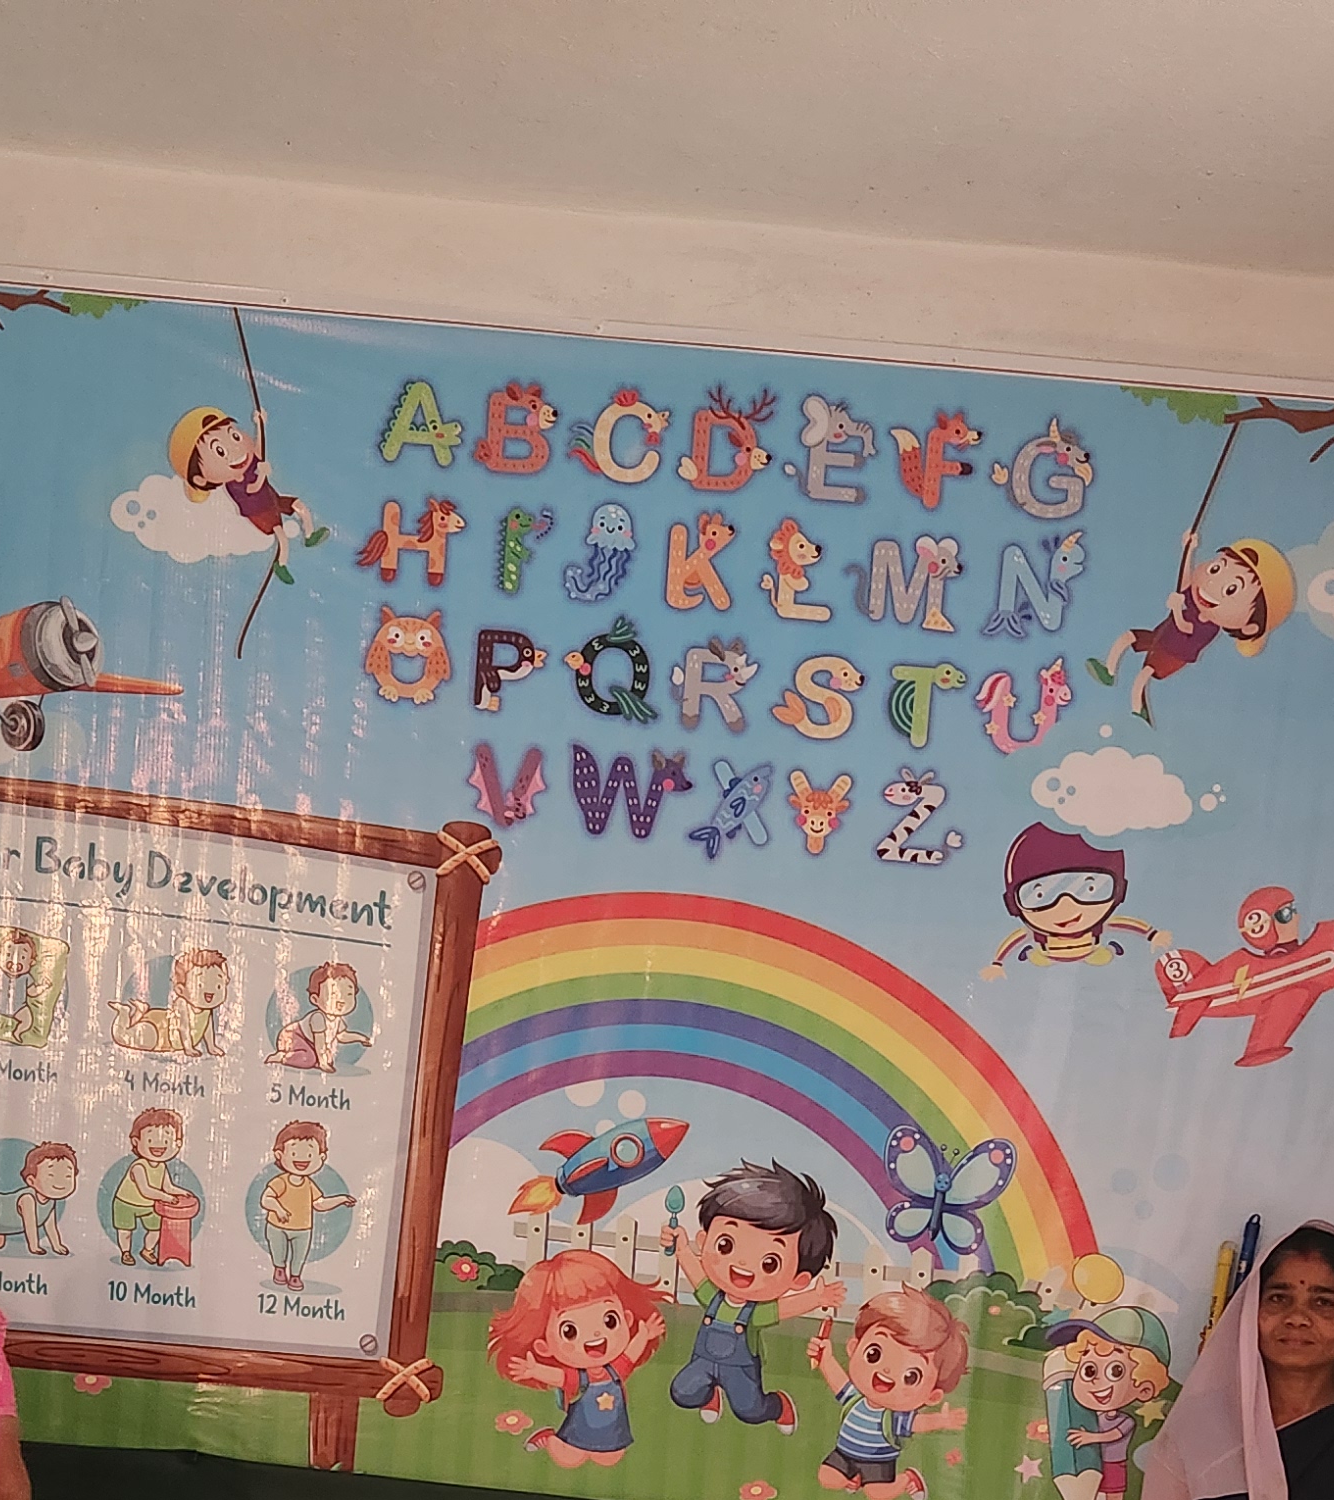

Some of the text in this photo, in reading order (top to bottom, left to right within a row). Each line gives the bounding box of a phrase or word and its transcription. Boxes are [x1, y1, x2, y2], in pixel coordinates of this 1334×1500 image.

[379, 380, 463, 466] A
[476, 382, 557, 474] B
[890, 410, 981, 509] F
[357, 498, 464, 586] H
[563, 503, 634, 600] J
[666, 513, 738, 611] K
[762, 517, 832, 622] L
[852, 535, 962, 632] M
[984, 533, 1086, 635] N
[367, 606, 1074, 755] O P Q R S T U
[468, 742, 546, 826] V
[573, 743, 692, 838] W
[788, 768, 852, 855] Y
[875, 767, 960, 865] Z
[35, 835, 135, 899] Baby
[145, 851, 392, 931] Development
[1169, 961, 1184, 979] 3
[125, 1070, 206, 1099] 4 Month
[269, 1083, 351, 1111] 5 Month
[108, 1281, 196, 1309] 10 Month
[257, 1294, 346, 1322] 12 Month
